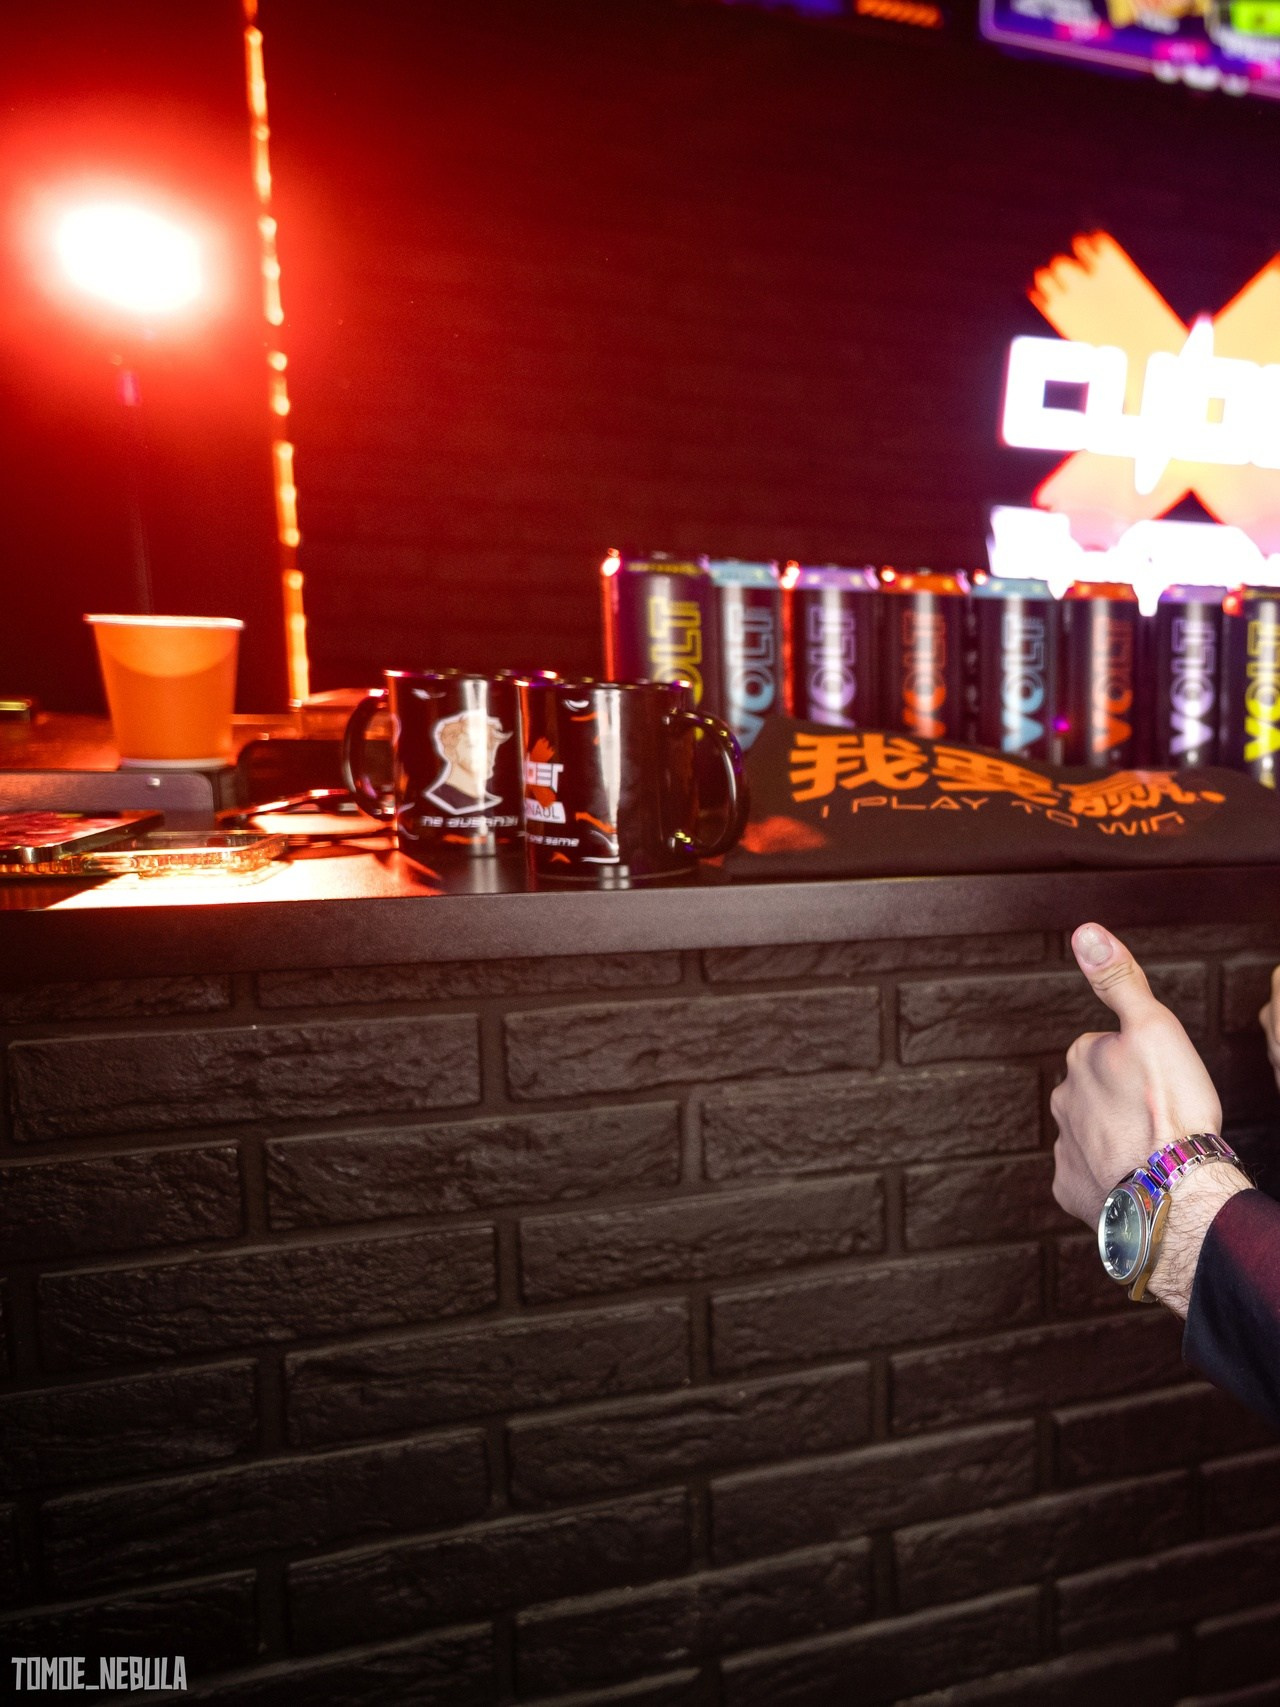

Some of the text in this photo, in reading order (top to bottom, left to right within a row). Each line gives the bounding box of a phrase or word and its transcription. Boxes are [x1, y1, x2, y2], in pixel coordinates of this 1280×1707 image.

[650, 596, 704, 733] OLT
[1001, 612, 1046, 754] VOLT
[1169, 616, 1216, 756] VOLT
[851, 796, 990, 813] PLAY
[1011, 801, 1079, 828] TO
